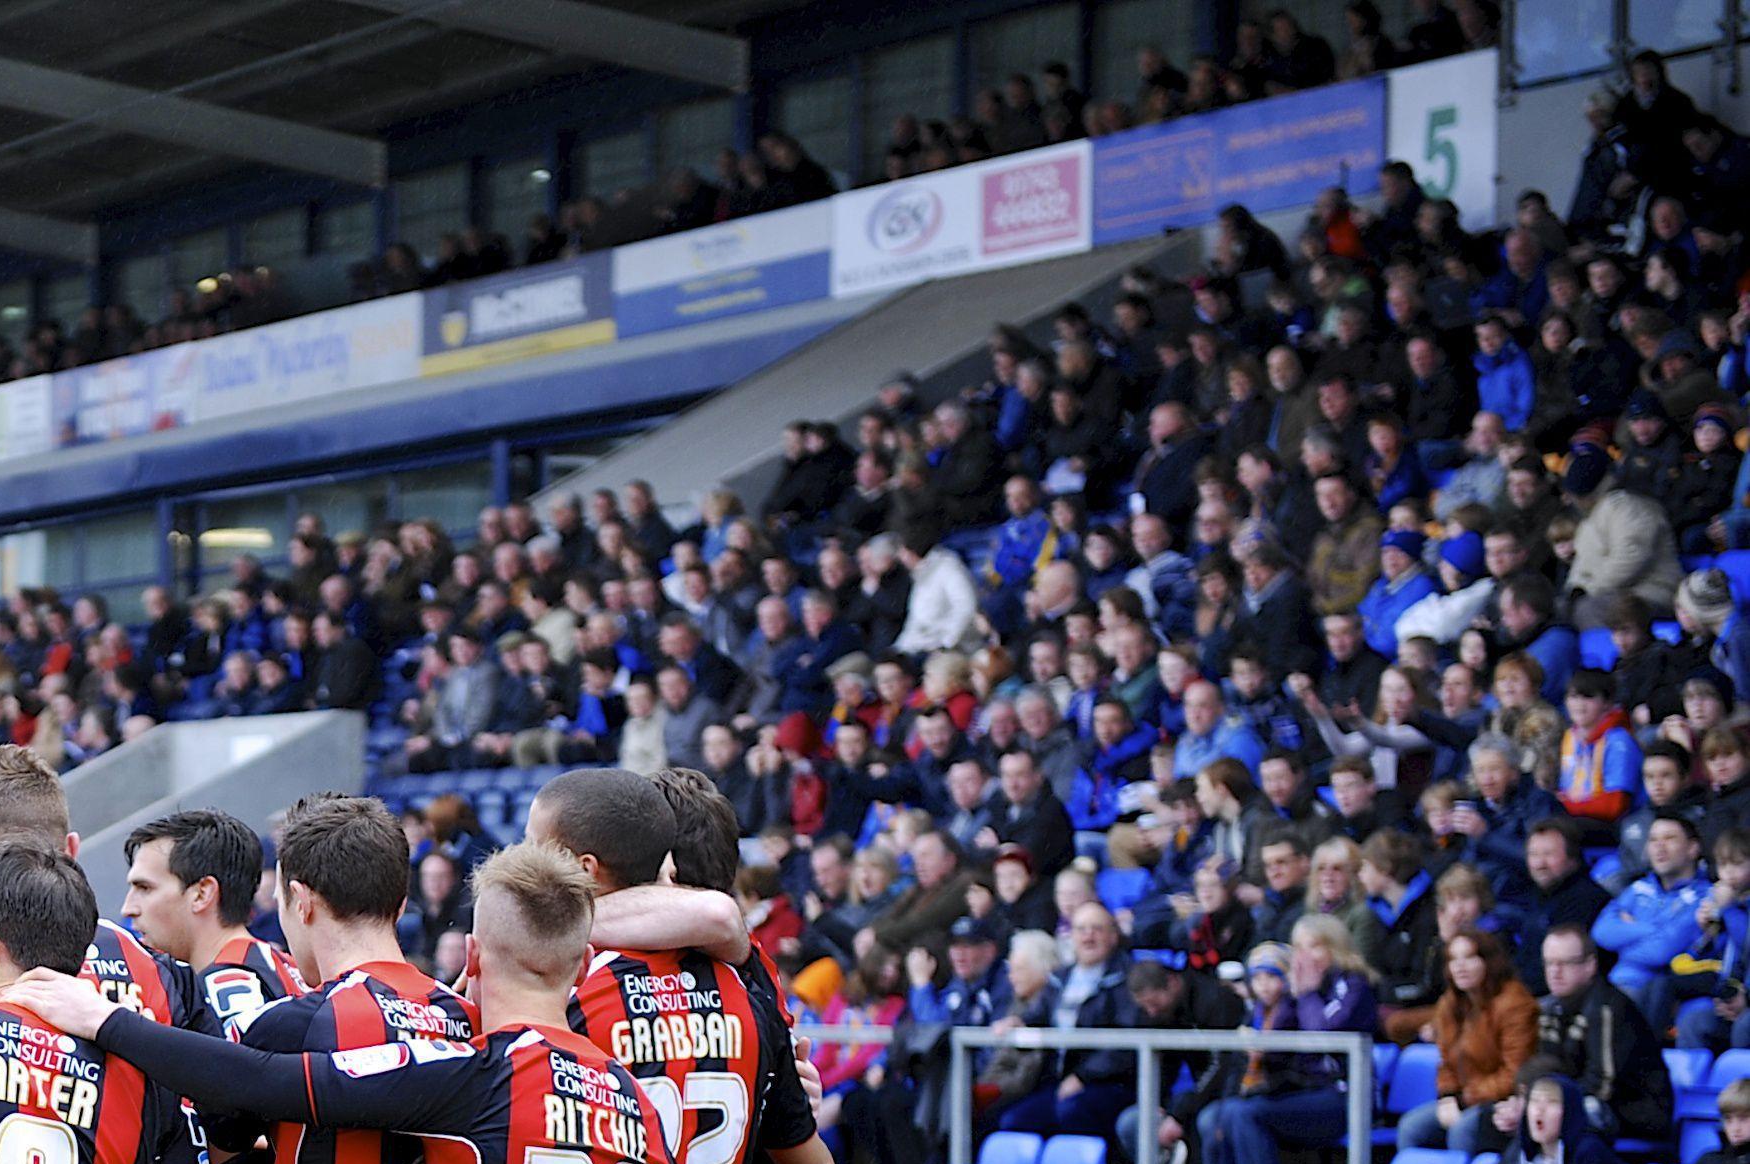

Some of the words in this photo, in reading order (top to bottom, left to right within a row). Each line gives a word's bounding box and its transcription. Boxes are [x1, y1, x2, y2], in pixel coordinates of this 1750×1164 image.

[1424, 103, 1459, 200] 5
[623, 972, 681, 994] ENERGY
[375, 992, 430, 1018] ENERGY
[628, 990, 722, 1014] CONSULTING
[382, 1008, 471, 1039] CONSULTING
[611, 1012, 743, 1065] GRABBAN
[550, 1051, 607, 1086] ENERGY
[553, 1071, 641, 1117] CONSULTING
[544, 1093, 648, 1164] RITCHIE
